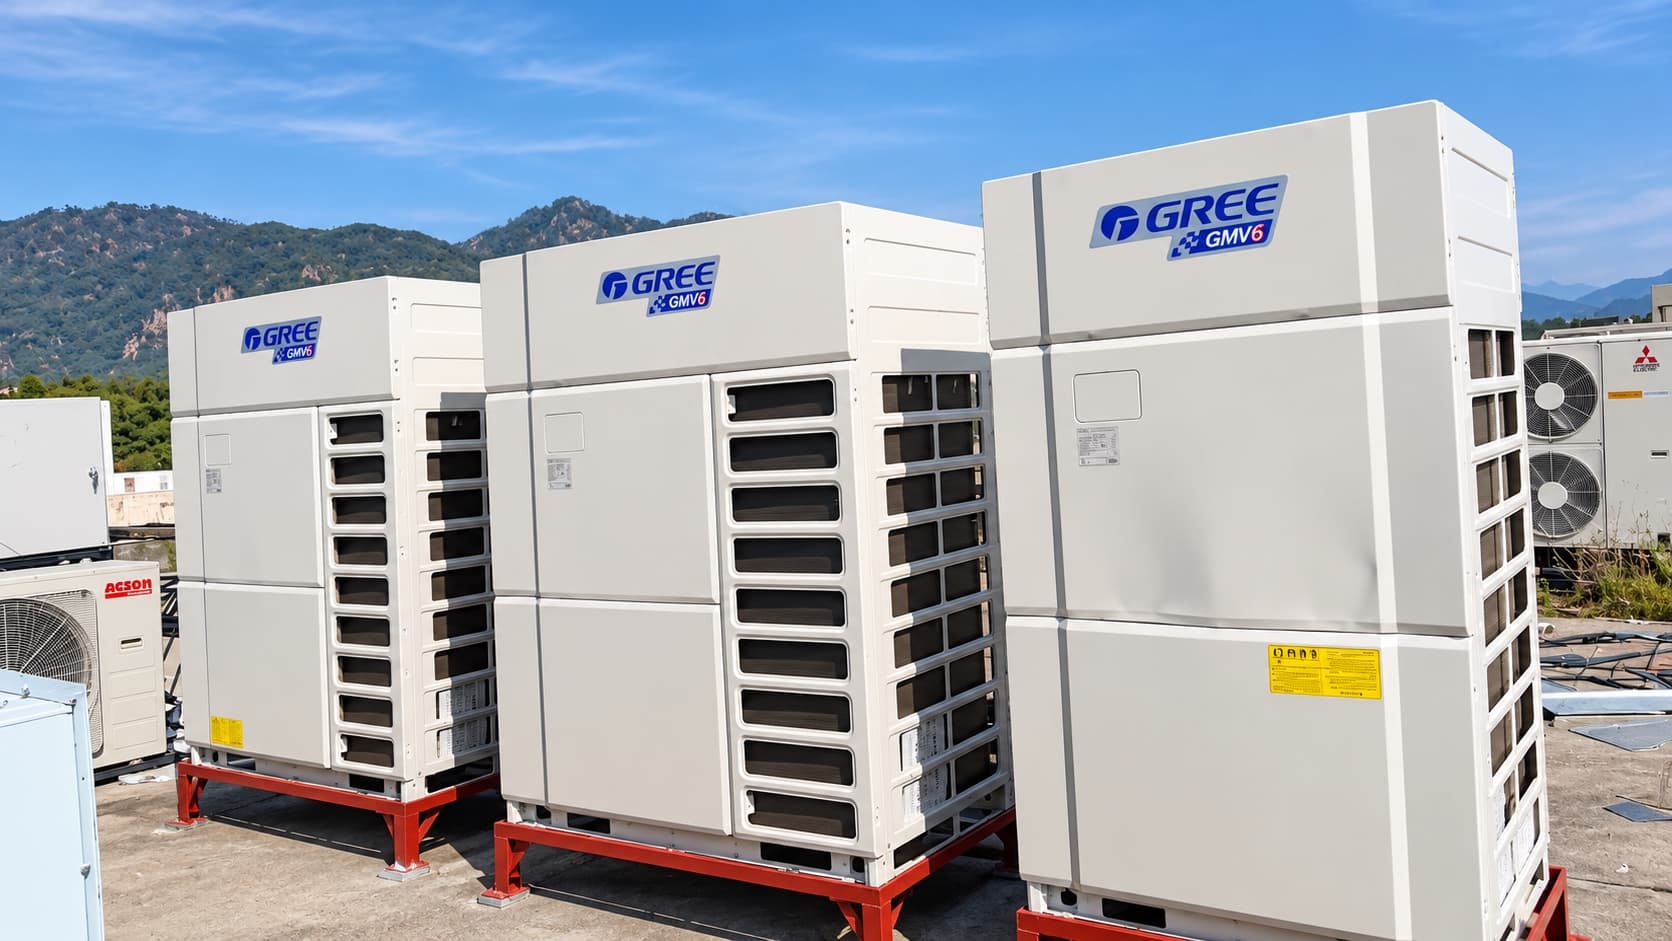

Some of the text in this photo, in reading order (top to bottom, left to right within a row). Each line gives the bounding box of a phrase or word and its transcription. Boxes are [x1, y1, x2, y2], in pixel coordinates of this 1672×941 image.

[1146, 183, 1279, 233] GREE
[1205, 223, 1265, 248] GMV6
[631, 261, 716, 295] GREE
[668, 291, 706, 309] GMV6
[263, 321, 319, 347] GREE
[286, 344, 313, 359] GMV6
[104, 578, 152, 593] ACSON
